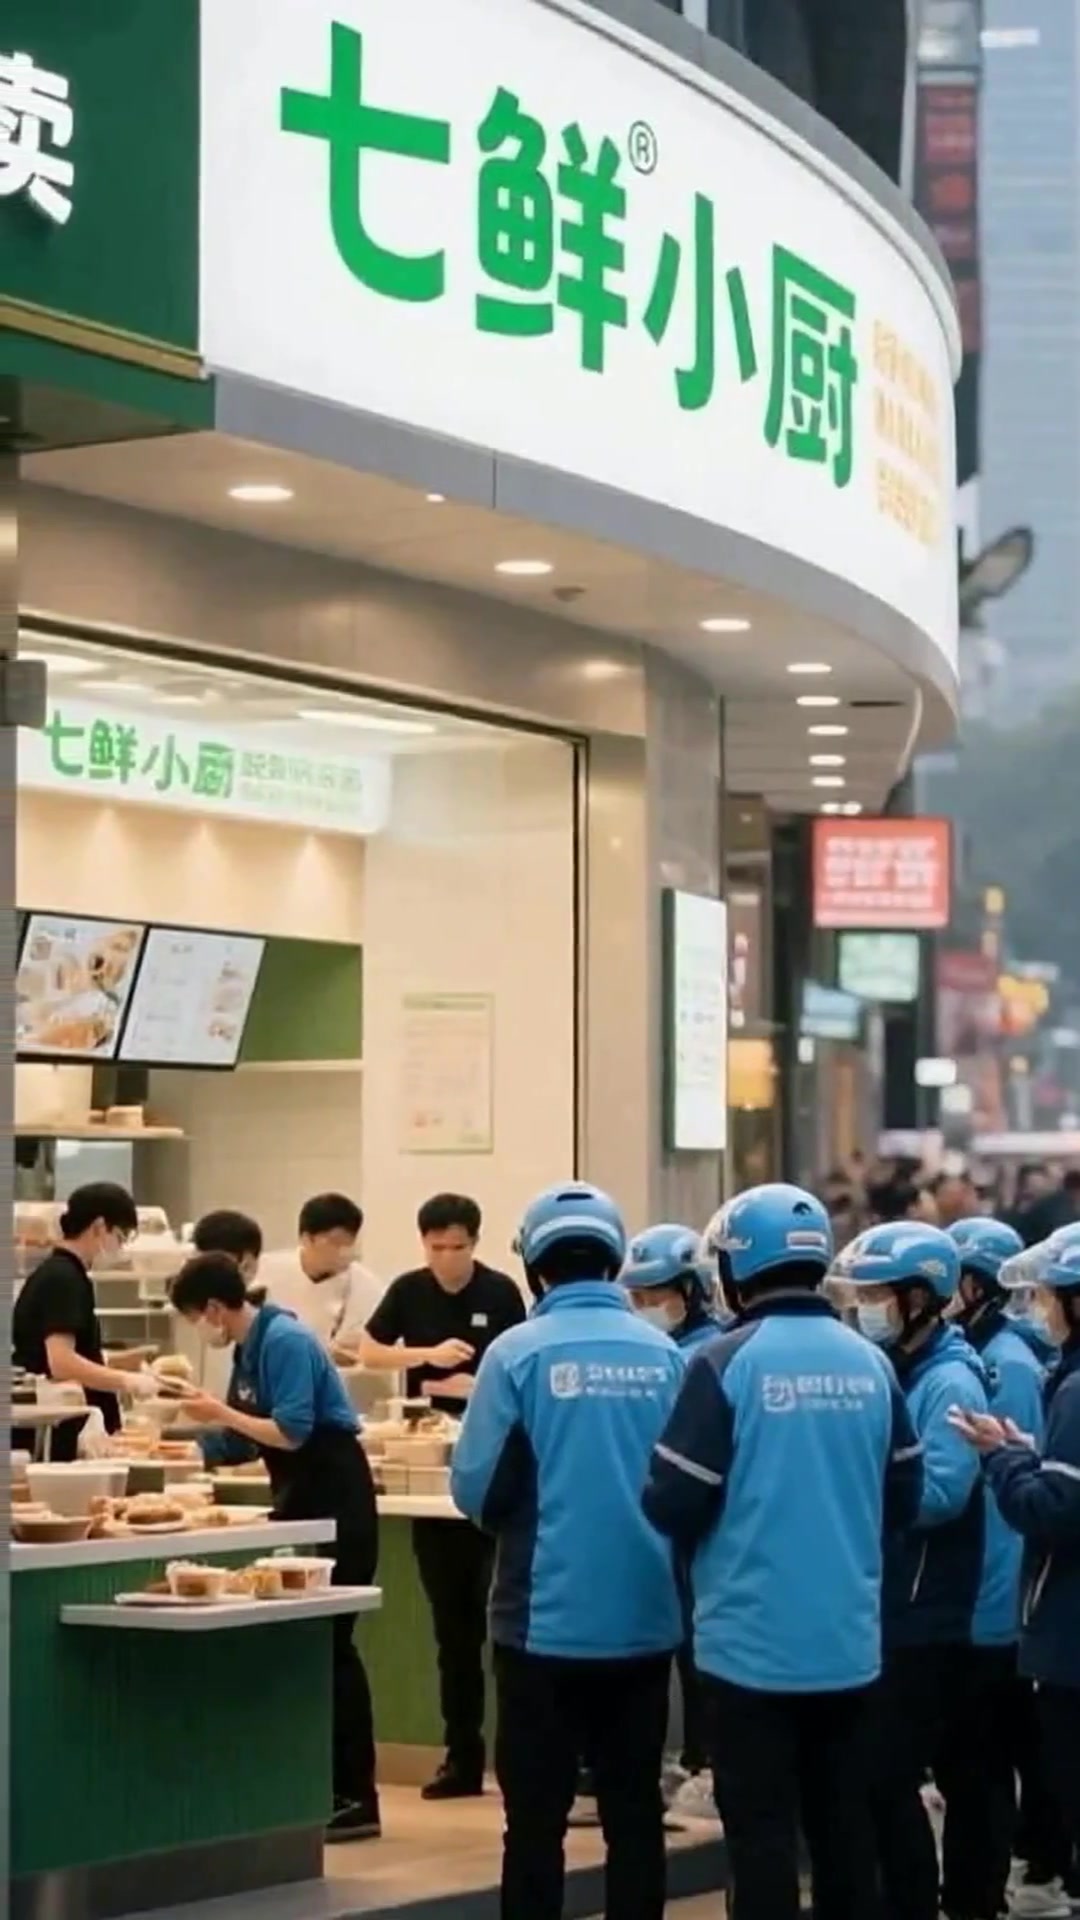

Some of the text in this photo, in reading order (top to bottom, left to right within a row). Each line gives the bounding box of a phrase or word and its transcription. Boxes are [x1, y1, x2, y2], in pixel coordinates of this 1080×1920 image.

[0, 52, 74, 224] 卖
[280, 21, 859, 488] 七鲜小厨
